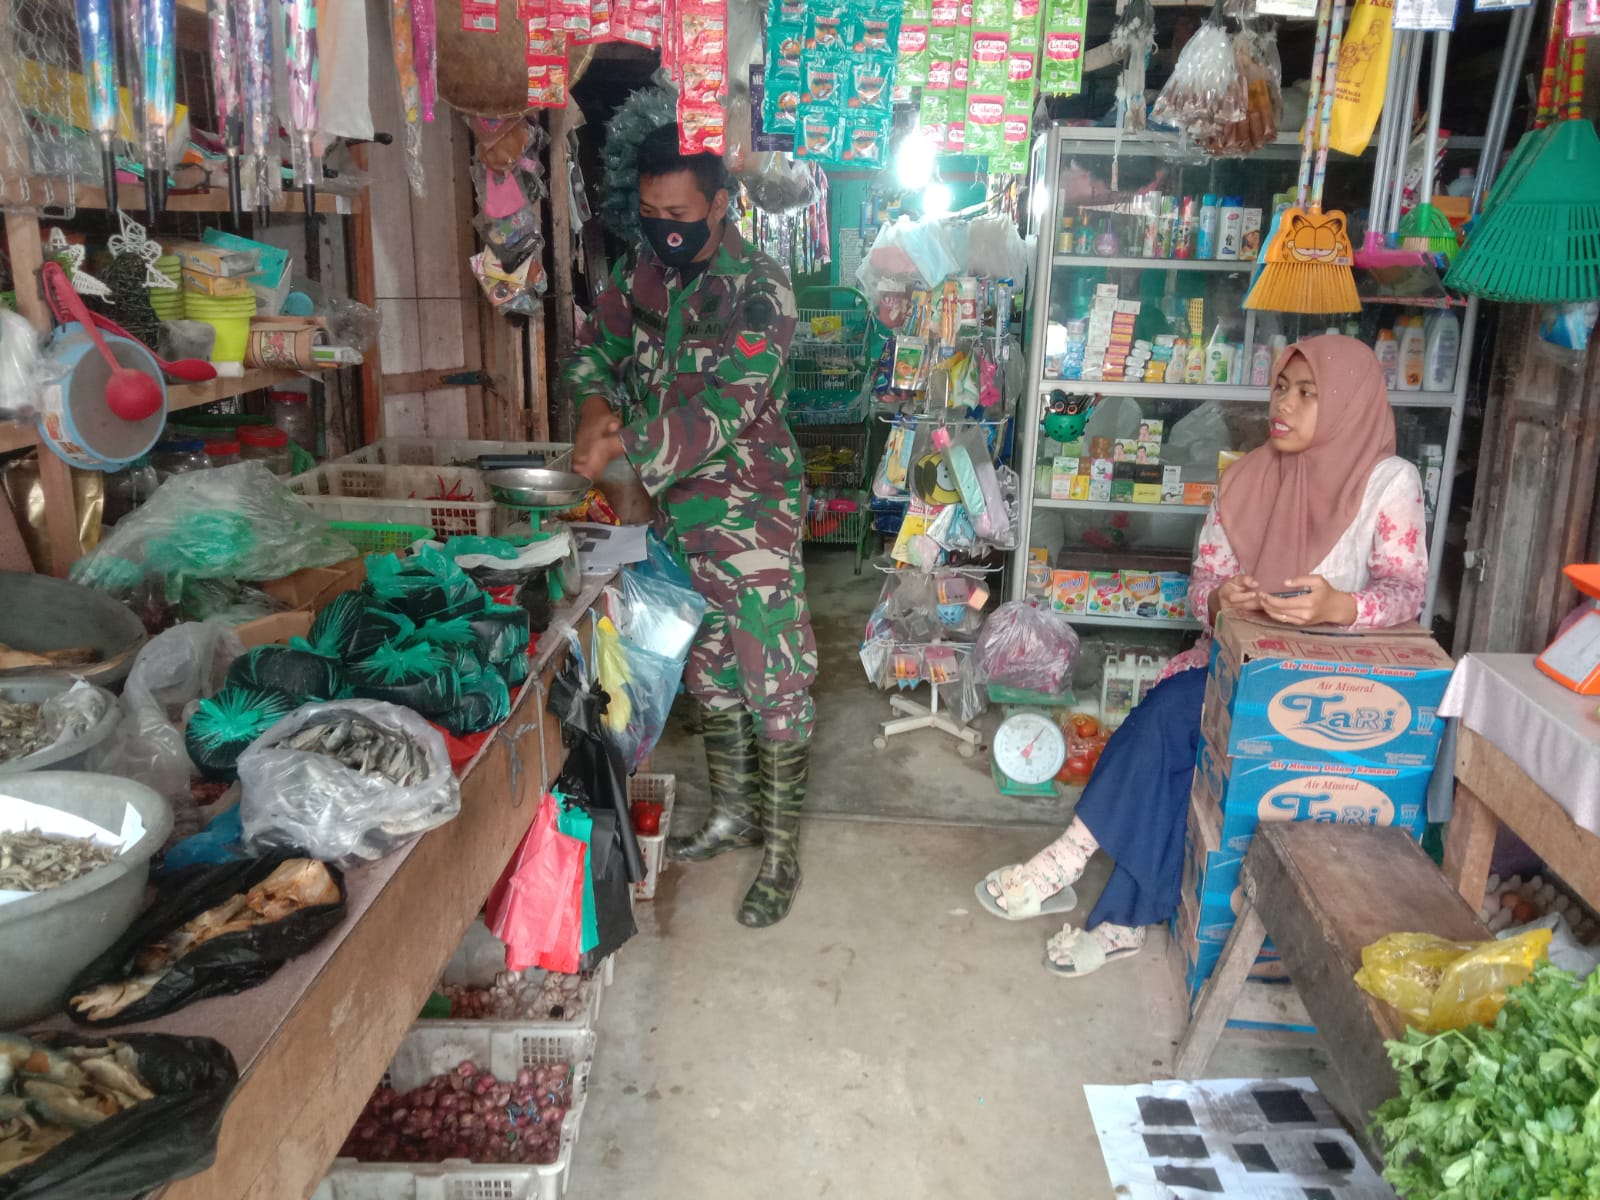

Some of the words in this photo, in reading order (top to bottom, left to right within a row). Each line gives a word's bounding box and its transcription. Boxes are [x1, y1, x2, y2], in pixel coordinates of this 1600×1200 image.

[752, 74, 764, 86] ME
[1281, 660, 1297, 670] Air
[1299, 662, 1334, 673] Minum
[1336, 664, 1369, 675] Dalam
[1371, 666, 1417, 678] Kemasan
[1316, 681, 1334, 691] Air
[1336, 682, 1375, 693] Mineral
[1269, 760, 1286, 770] Air
[1287, 762, 1320, 773] Minum
[1321, 764, 1353, 775] Dalam
[1355, 766, 1399, 777] Kemasan
[1304, 780, 1319, 789] Air
[1321, 780, 1360, 792] Mineral
